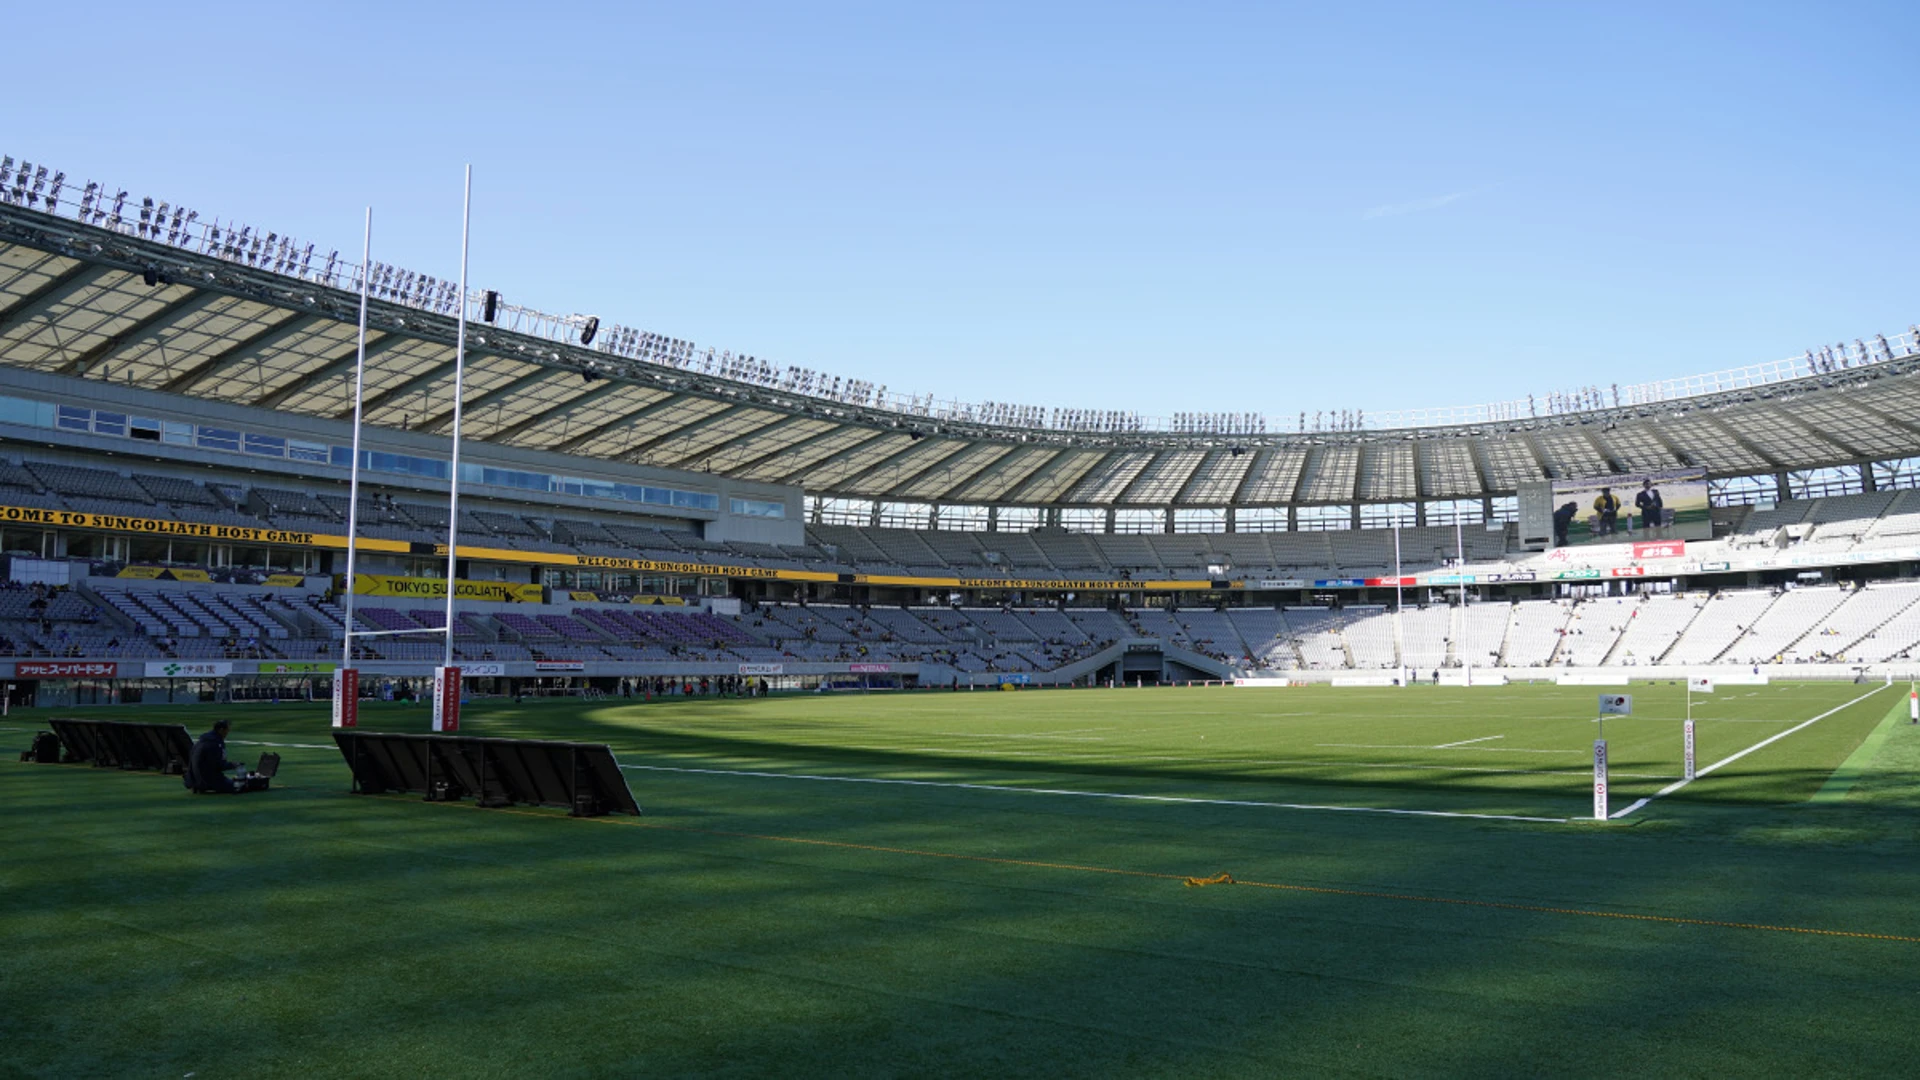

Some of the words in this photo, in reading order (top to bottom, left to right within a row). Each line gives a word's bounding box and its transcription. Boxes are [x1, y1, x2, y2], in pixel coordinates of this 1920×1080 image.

[0, 507, 54, 522] OME
[60, 513, 86, 525] TO
[92, 516, 211, 535] SUNGOLIATH
[217, 527, 262, 541] HOST
[266, 531, 313, 544] GAME
[577, 556, 634, 569] WELCOME
[637, 560, 651, 569] TO
[653, 561, 720, 574] SUNGOLIATH
[722, 567, 748, 576] HOST
[751, 569, 779, 578] GAME
[386, 580, 430, 594] TOKYO
[1025, 580, 1086, 588] SUNGOLIATH
[1117, 581, 1147, 589] GAME
[20, 664, 114, 675] アサヒスーパードライ
